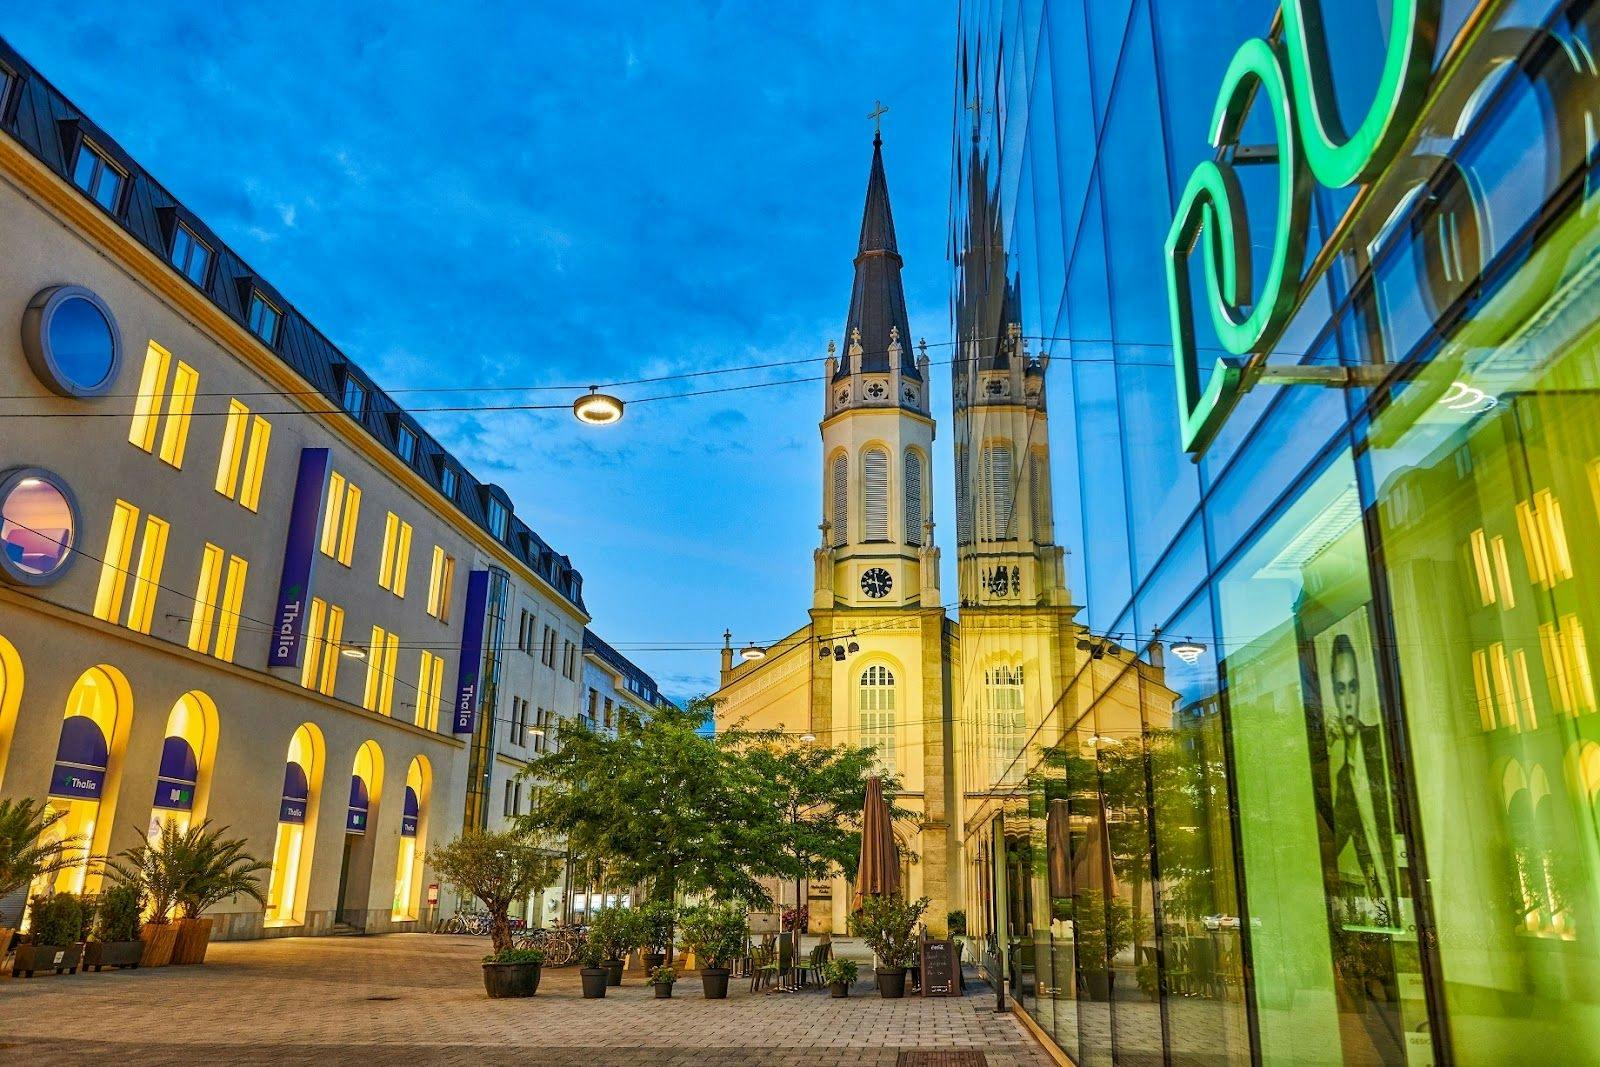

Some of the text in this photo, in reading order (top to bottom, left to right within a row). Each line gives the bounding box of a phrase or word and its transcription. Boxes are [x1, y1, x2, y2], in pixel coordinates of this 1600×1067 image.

[278, 601, 300, 658] Thalia
[460, 684, 474, 727] Thalia
[72, 777, 97, 790] Thalia
[288, 807, 302, 817] Thalia
